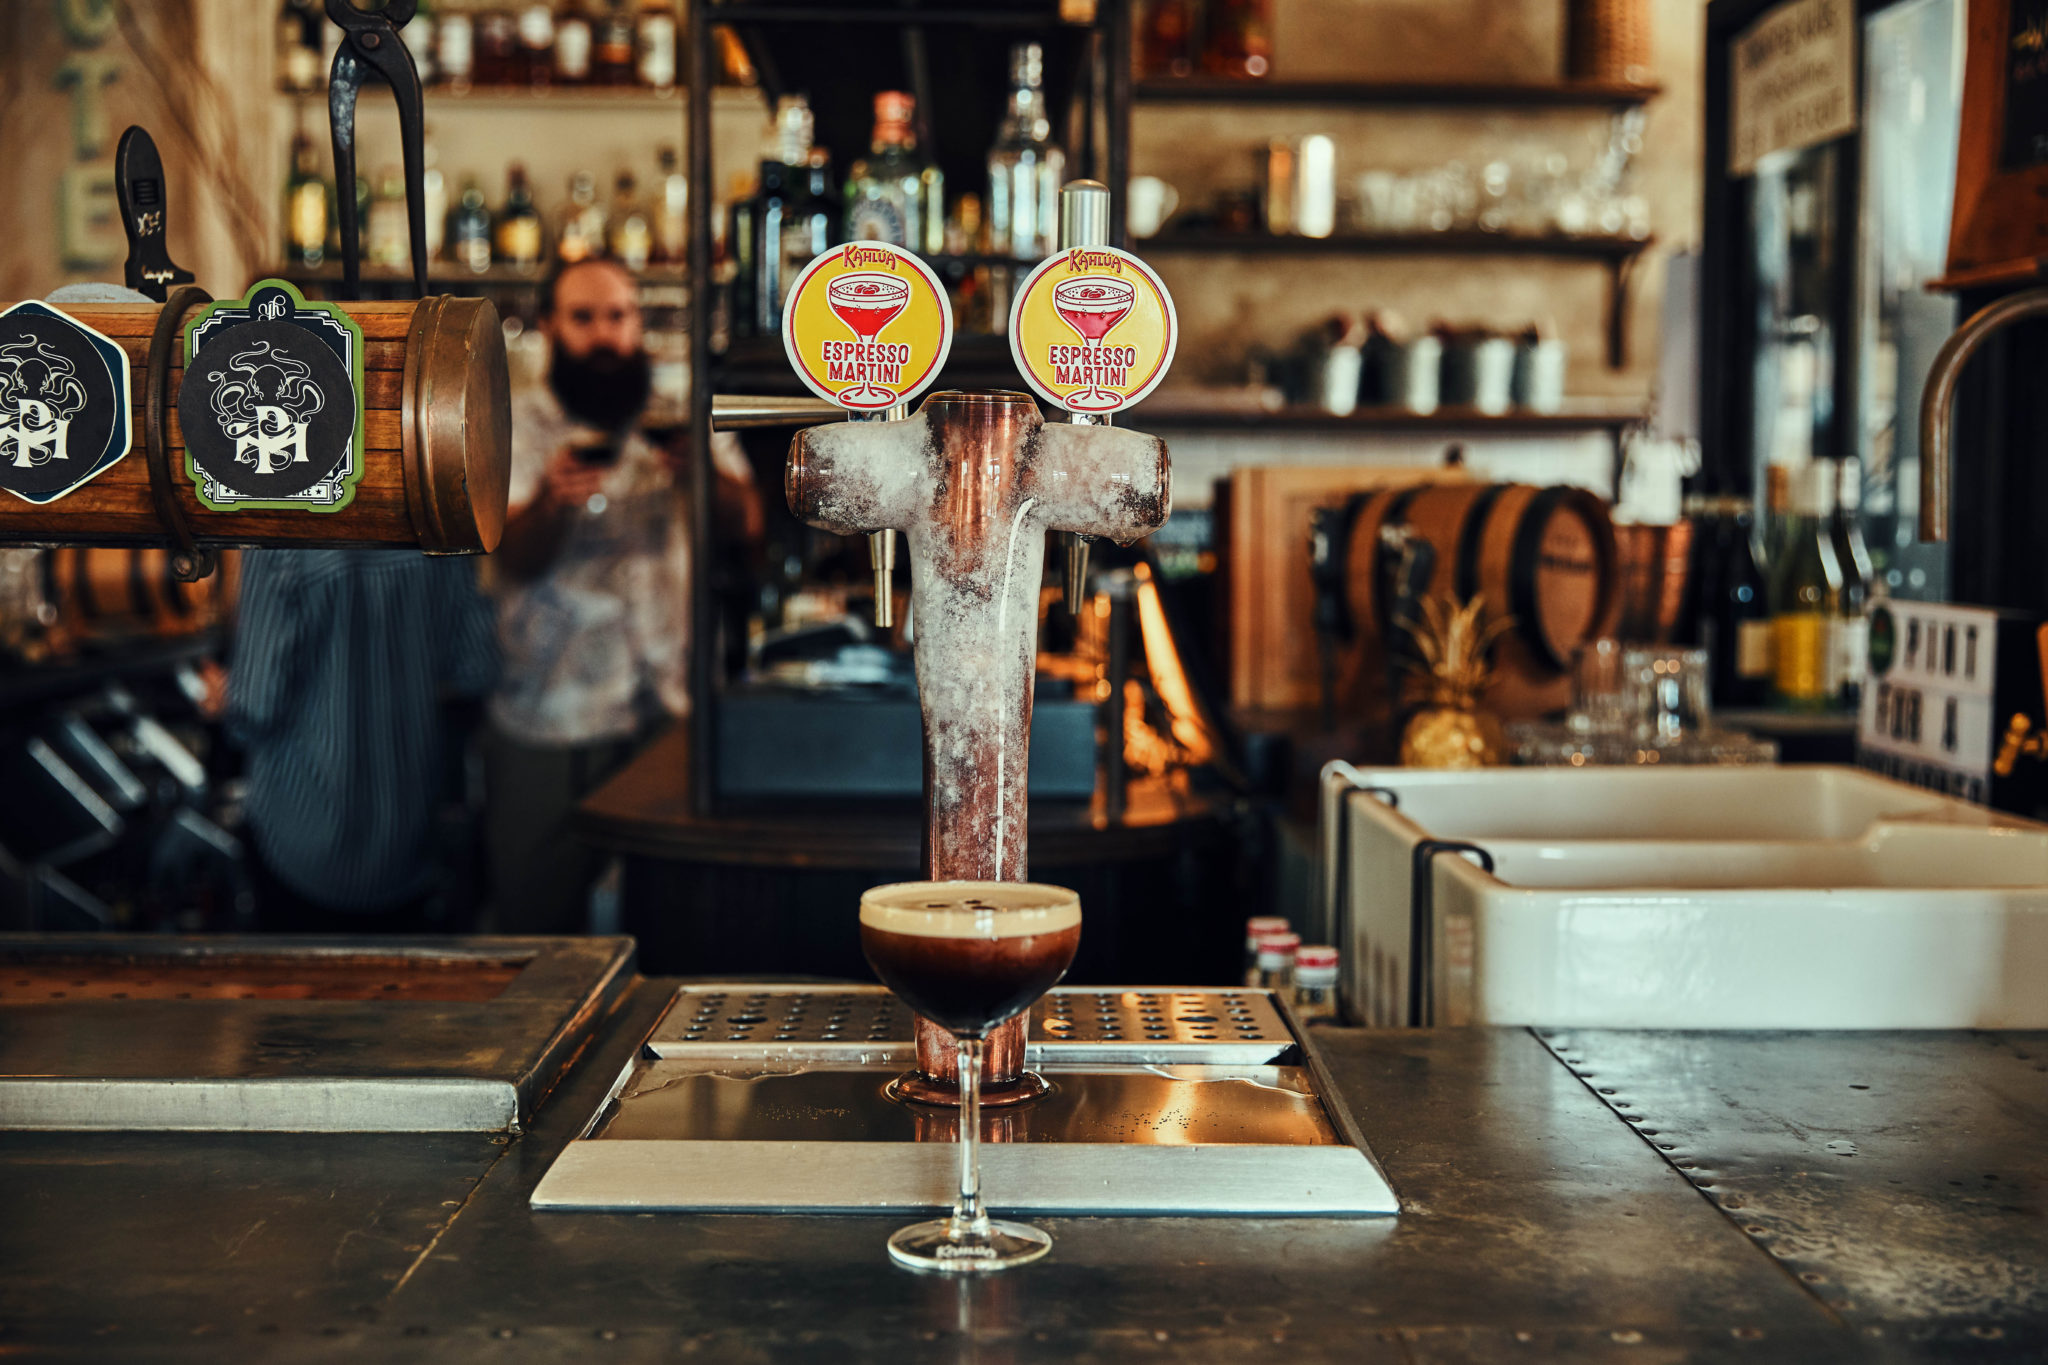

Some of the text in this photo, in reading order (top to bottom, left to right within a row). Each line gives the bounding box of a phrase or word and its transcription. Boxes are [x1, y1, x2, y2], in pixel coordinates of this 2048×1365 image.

[844, 245, 897, 270] KAHLÚA
[1069, 250, 1122, 273] KAHLÚA
[822, 341, 909, 364] ESPRESSO
[1050, 346, 1135, 367] ESPRESSO
[828, 361, 901, 383] MARTINI
[1055, 365, 1127, 387] MARTINI
